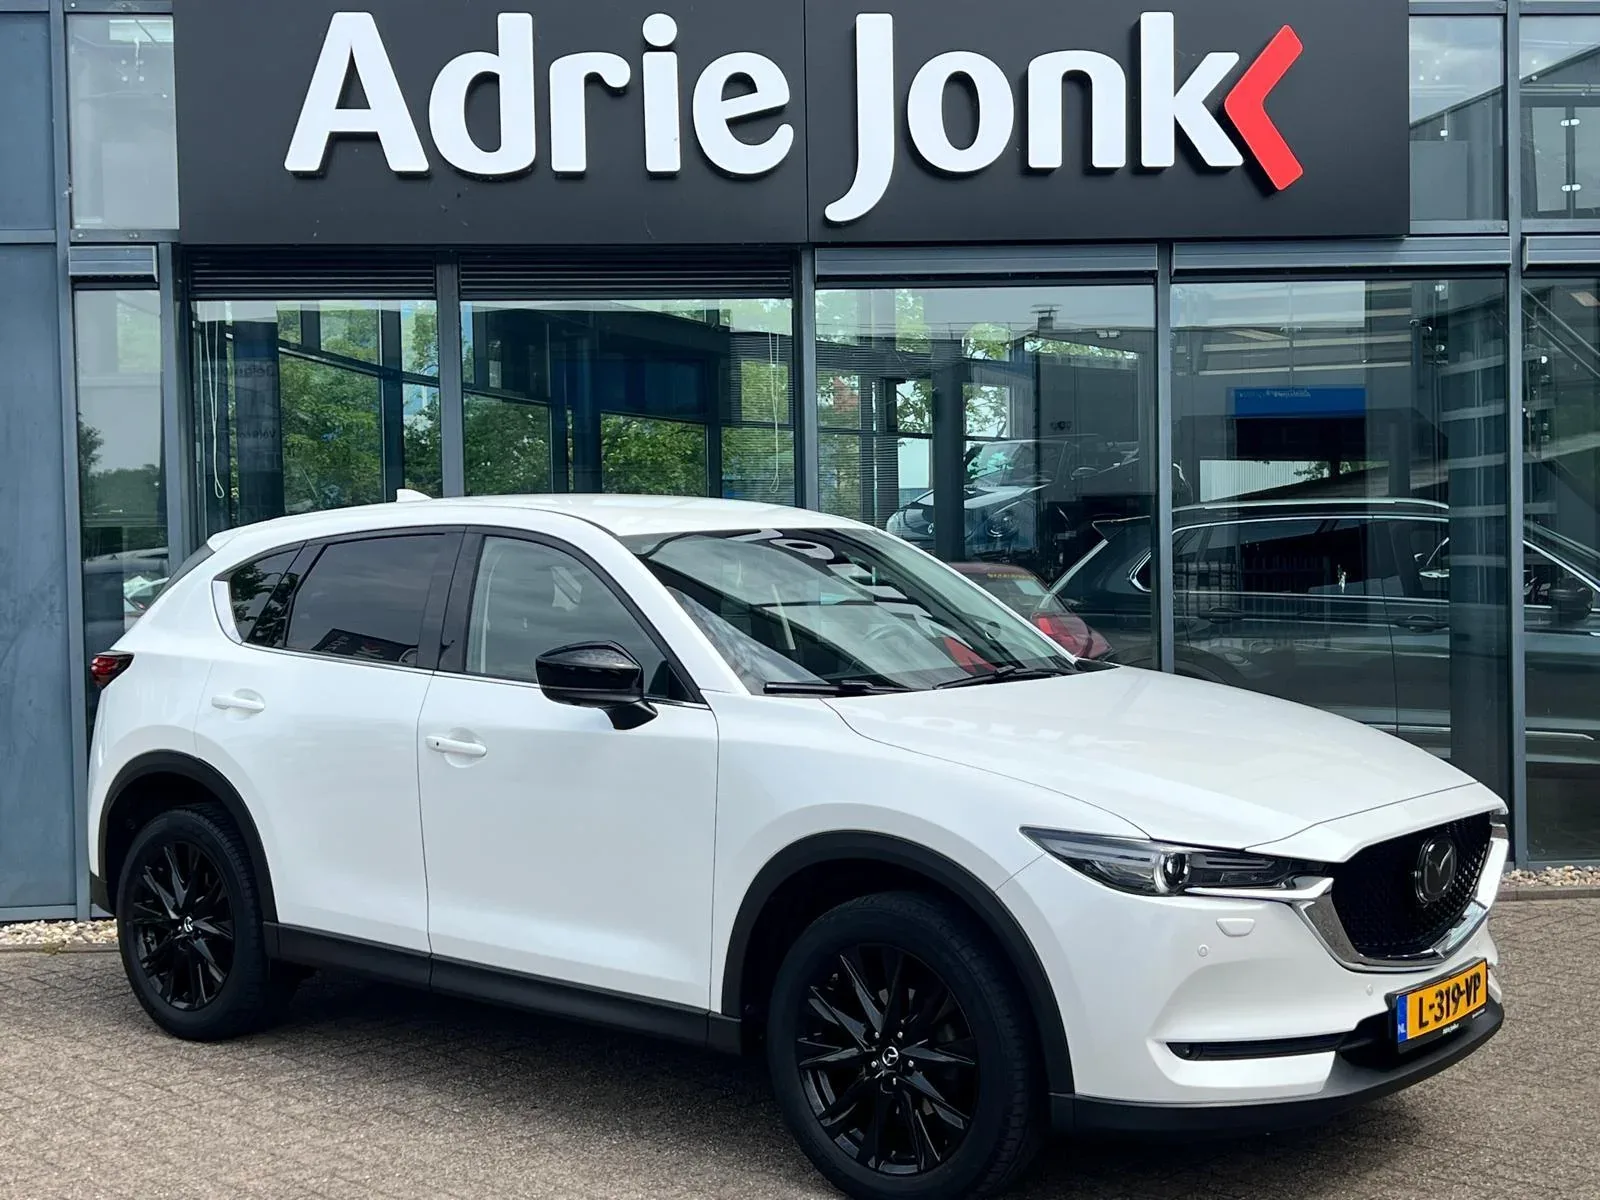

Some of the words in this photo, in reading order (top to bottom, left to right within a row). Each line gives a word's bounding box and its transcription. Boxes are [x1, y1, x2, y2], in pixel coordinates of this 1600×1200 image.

[284, 11, 795, 175] Adrie
[824, 10, 1244, 223] Jonk
[1418, 973, 1481, 1029] L-319-VP
